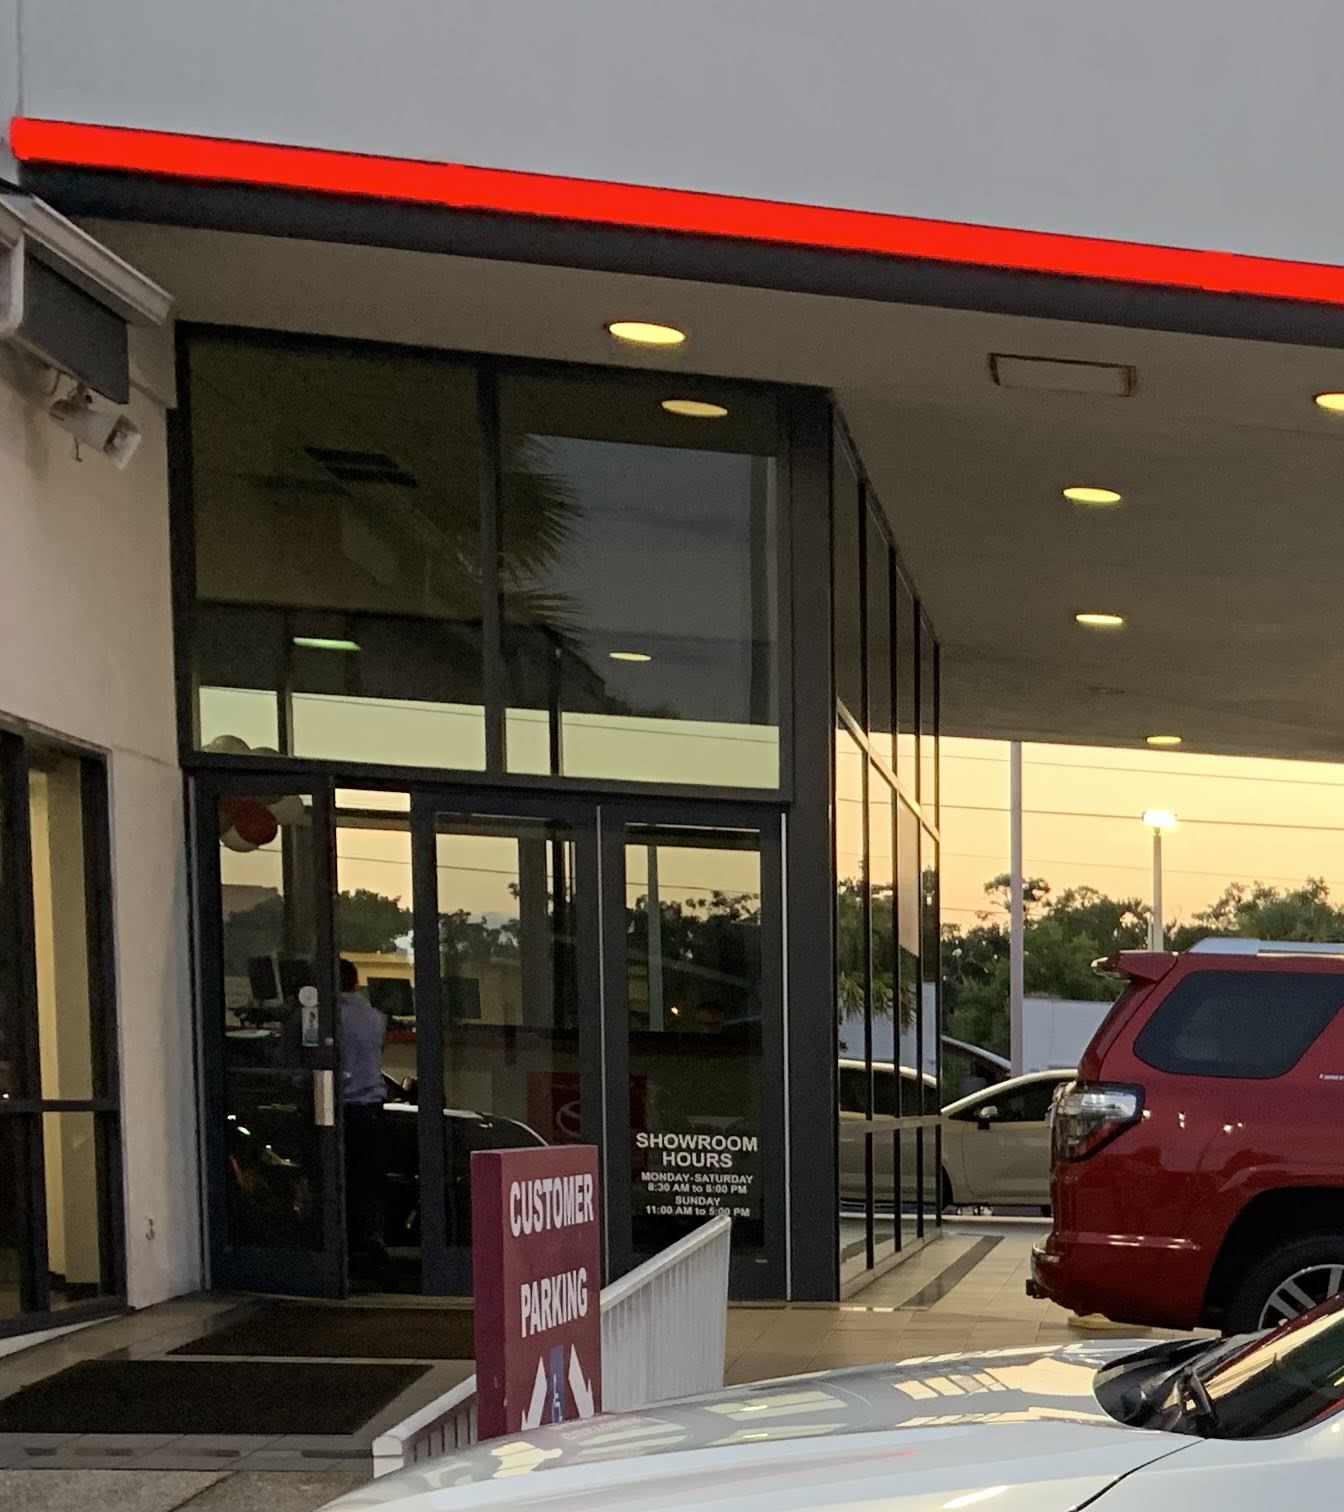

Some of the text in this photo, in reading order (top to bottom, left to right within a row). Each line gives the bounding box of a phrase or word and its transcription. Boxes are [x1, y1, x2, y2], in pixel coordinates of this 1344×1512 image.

[636, 1132, 758, 1151] SHOWROOM
[662, 1151, 733, 1167] HOURS
[647, 1183, 670, 1192] 8:30
[672, 1183, 690, 1193] AM
[692, 1184, 703, 1193] to
[730, 1185, 747, 1194] PM
[510, 1174, 594, 1237] CUSTOMER
[675, 1195, 721, 1206] SUNDAY
[645, 1205, 673, 1215] 11:00
[675, 1206, 693, 1216] AM
[695, 1206, 706, 1216] to
[733, 1207, 750, 1216] PM
[520, 1267, 588, 1338] PARKING
